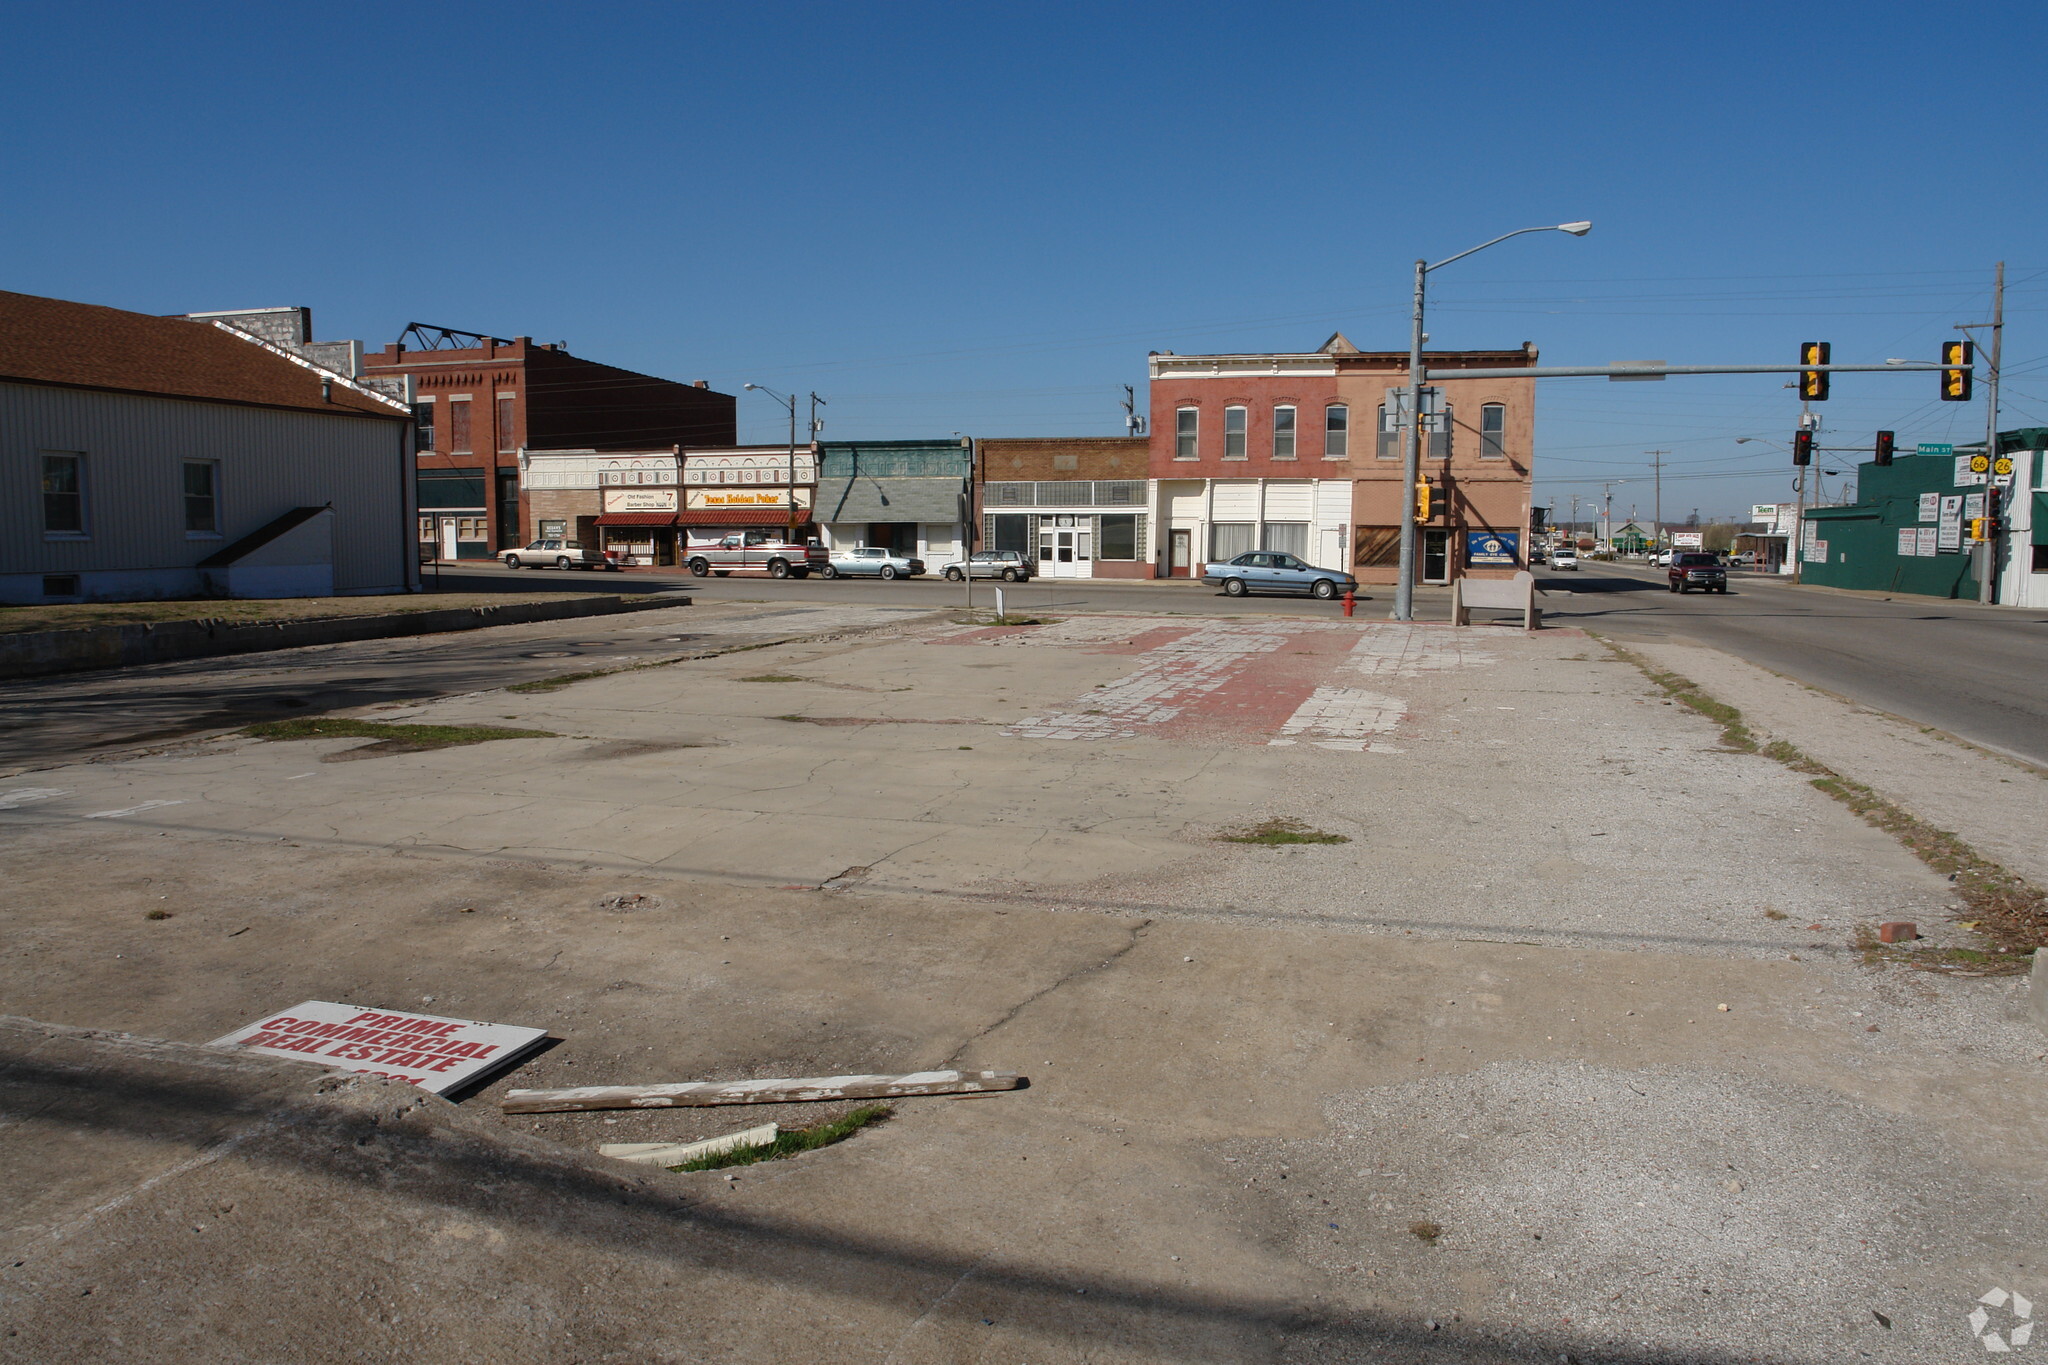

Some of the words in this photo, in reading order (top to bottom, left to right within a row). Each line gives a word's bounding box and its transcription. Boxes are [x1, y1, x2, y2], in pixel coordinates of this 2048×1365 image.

[1918, 445, 1939, 453] Main
[1973, 459, 1986, 469] 66
[1997, 461, 2010, 471] 26
[726, 494, 755, 504] Holdem
[345, 1012, 467, 1038] PRIME
[259, 1017, 501, 1060] COMMERCIAL
[237, 1031, 328, 1055] REAL
[332, 1042, 467, 1073] ESTATE
